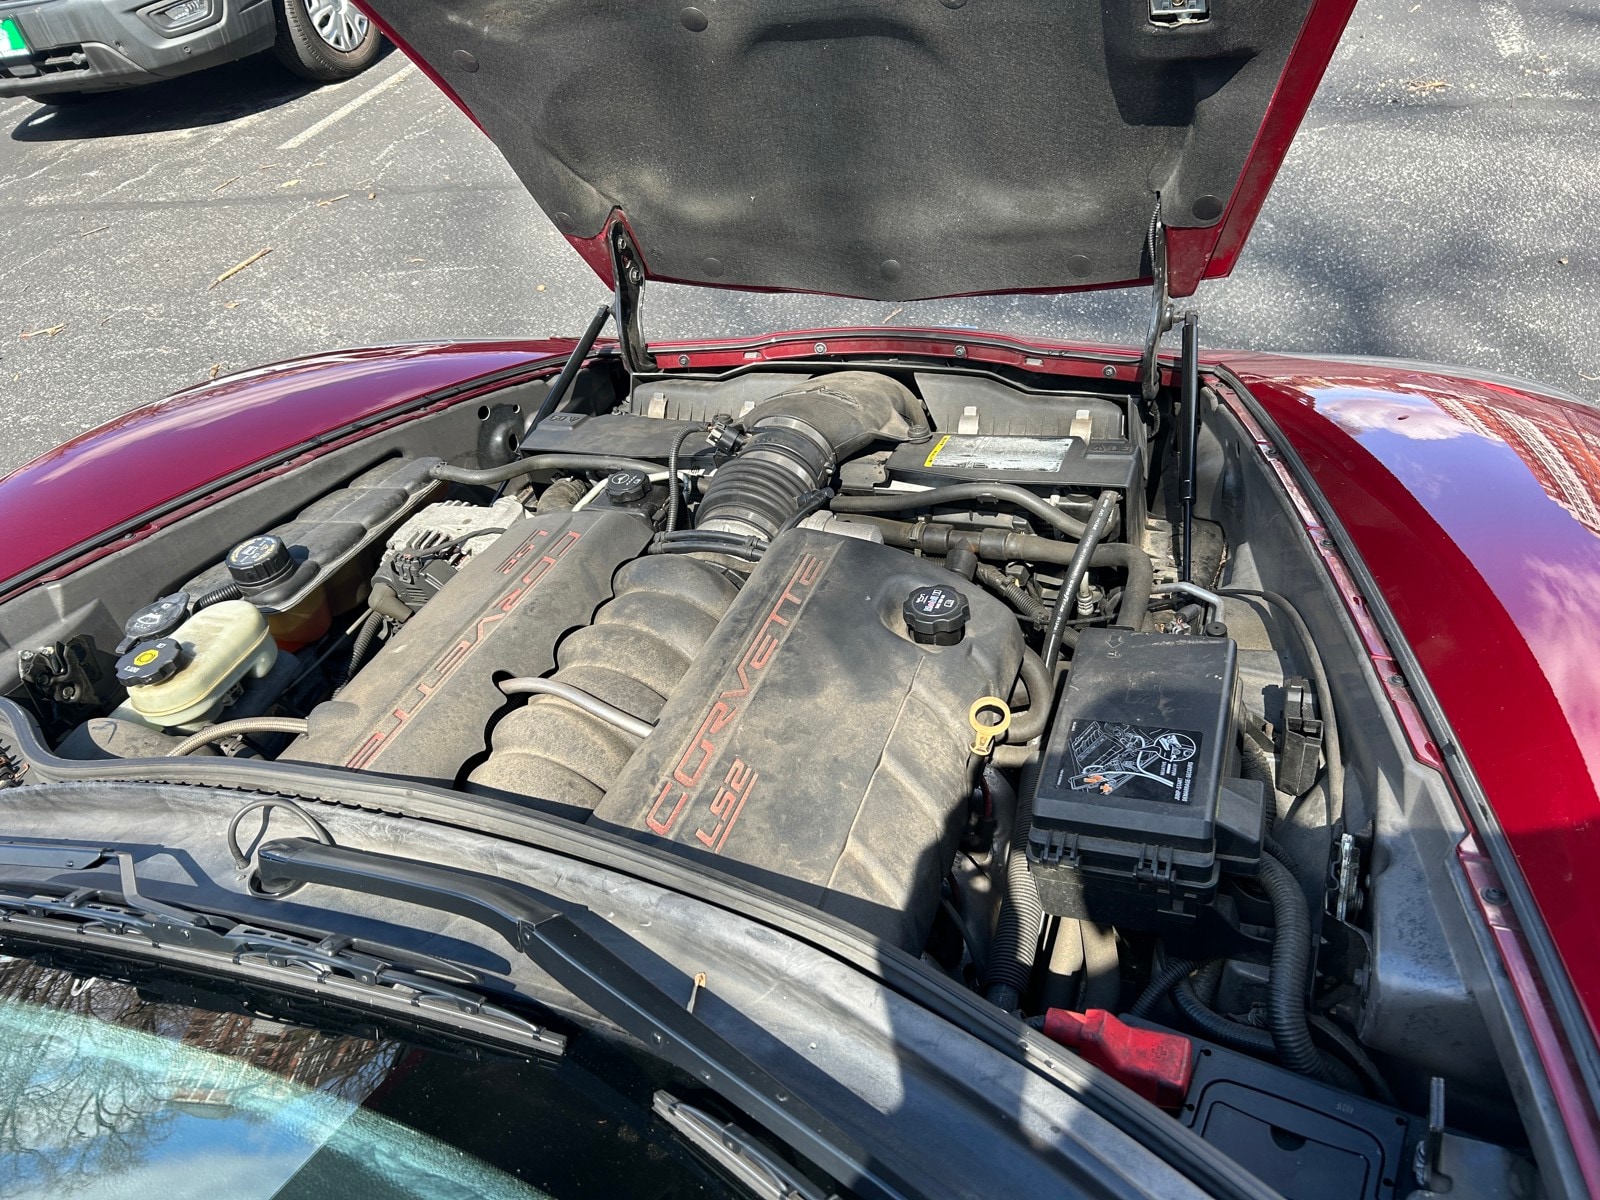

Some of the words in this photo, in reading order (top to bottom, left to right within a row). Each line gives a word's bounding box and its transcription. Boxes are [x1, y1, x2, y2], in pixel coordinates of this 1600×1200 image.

[500, 530, 547, 574] LS2
[347, 531, 581, 770] CORVETTE
[645, 553, 823, 835] CORVETTE
[695, 758, 753, 848] LS2
